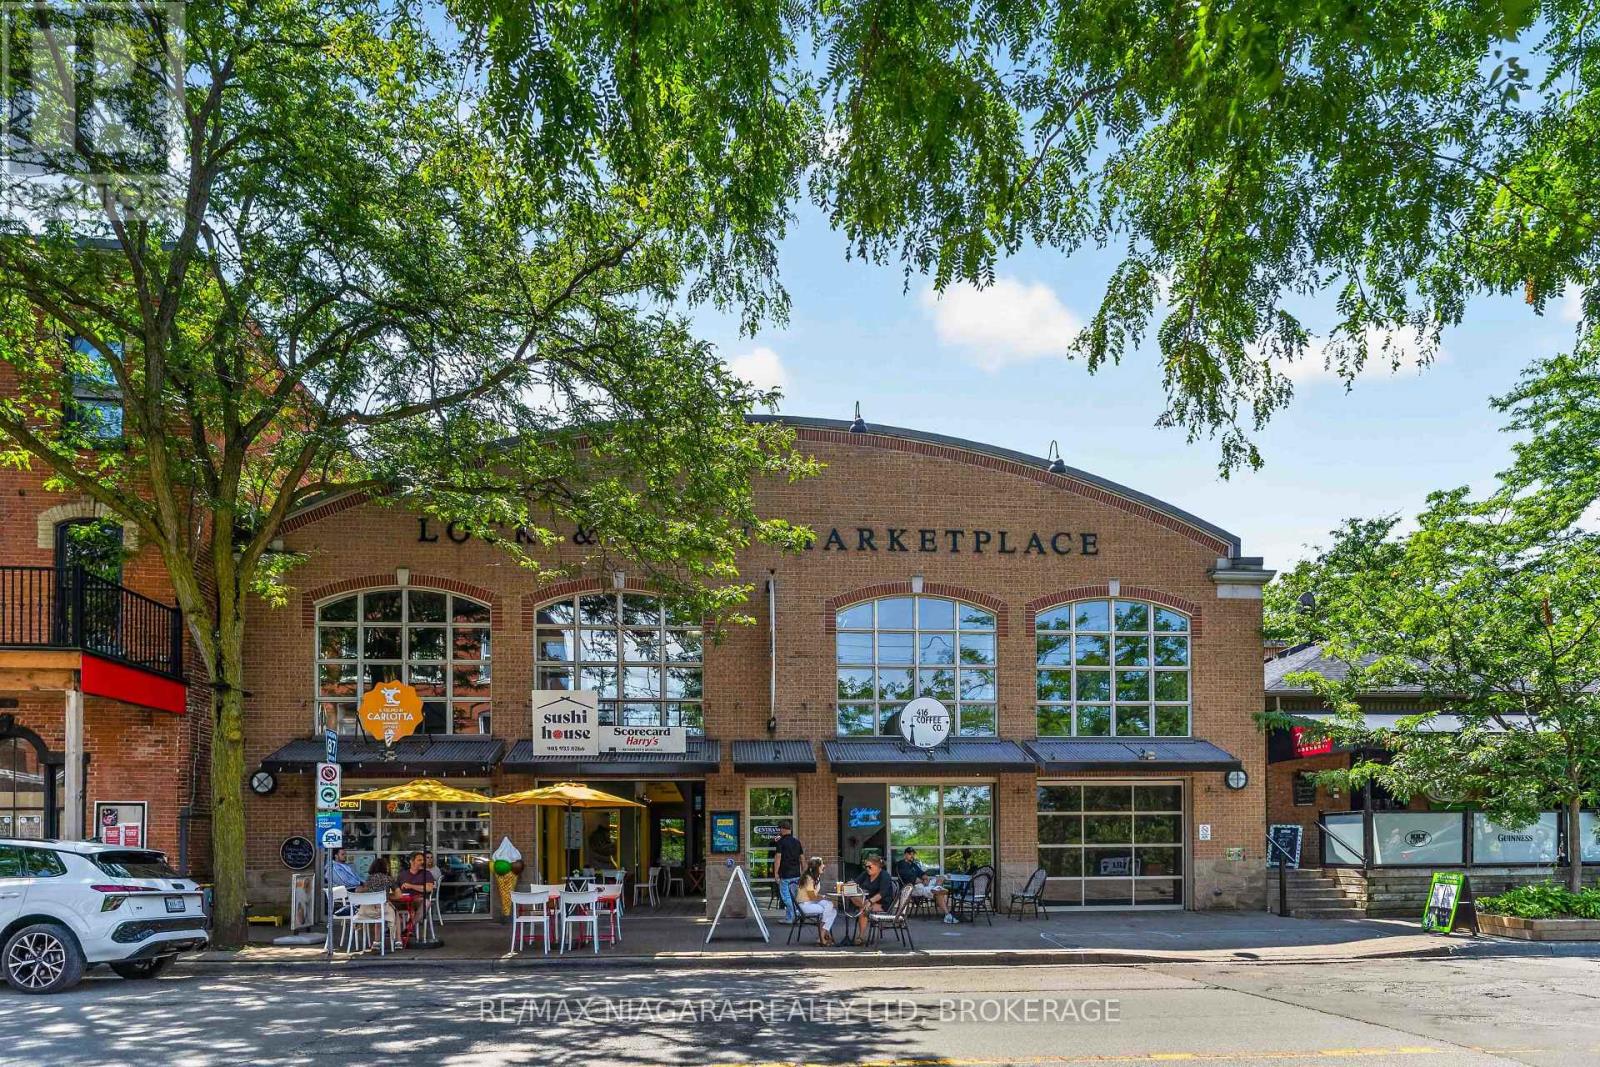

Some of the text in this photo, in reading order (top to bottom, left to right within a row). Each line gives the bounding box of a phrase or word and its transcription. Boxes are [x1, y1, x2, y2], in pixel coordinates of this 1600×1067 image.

[800, 527, 1099, 556] ARKETPLACE
[367, 712, 414, 721] CARLOTTA
[543, 709, 588, 724] sushi
[916, 708, 929, 716] 416
[916, 715, 942, 724] COFFEE
[541, 725, 591, 740] house
[613, 727, 671, 736] Scorecard
[932, 724, 944, 732] CO.
[626, 736, 659, 747] Harry's
[1497, 833, 1534, 842] GUINNESS
